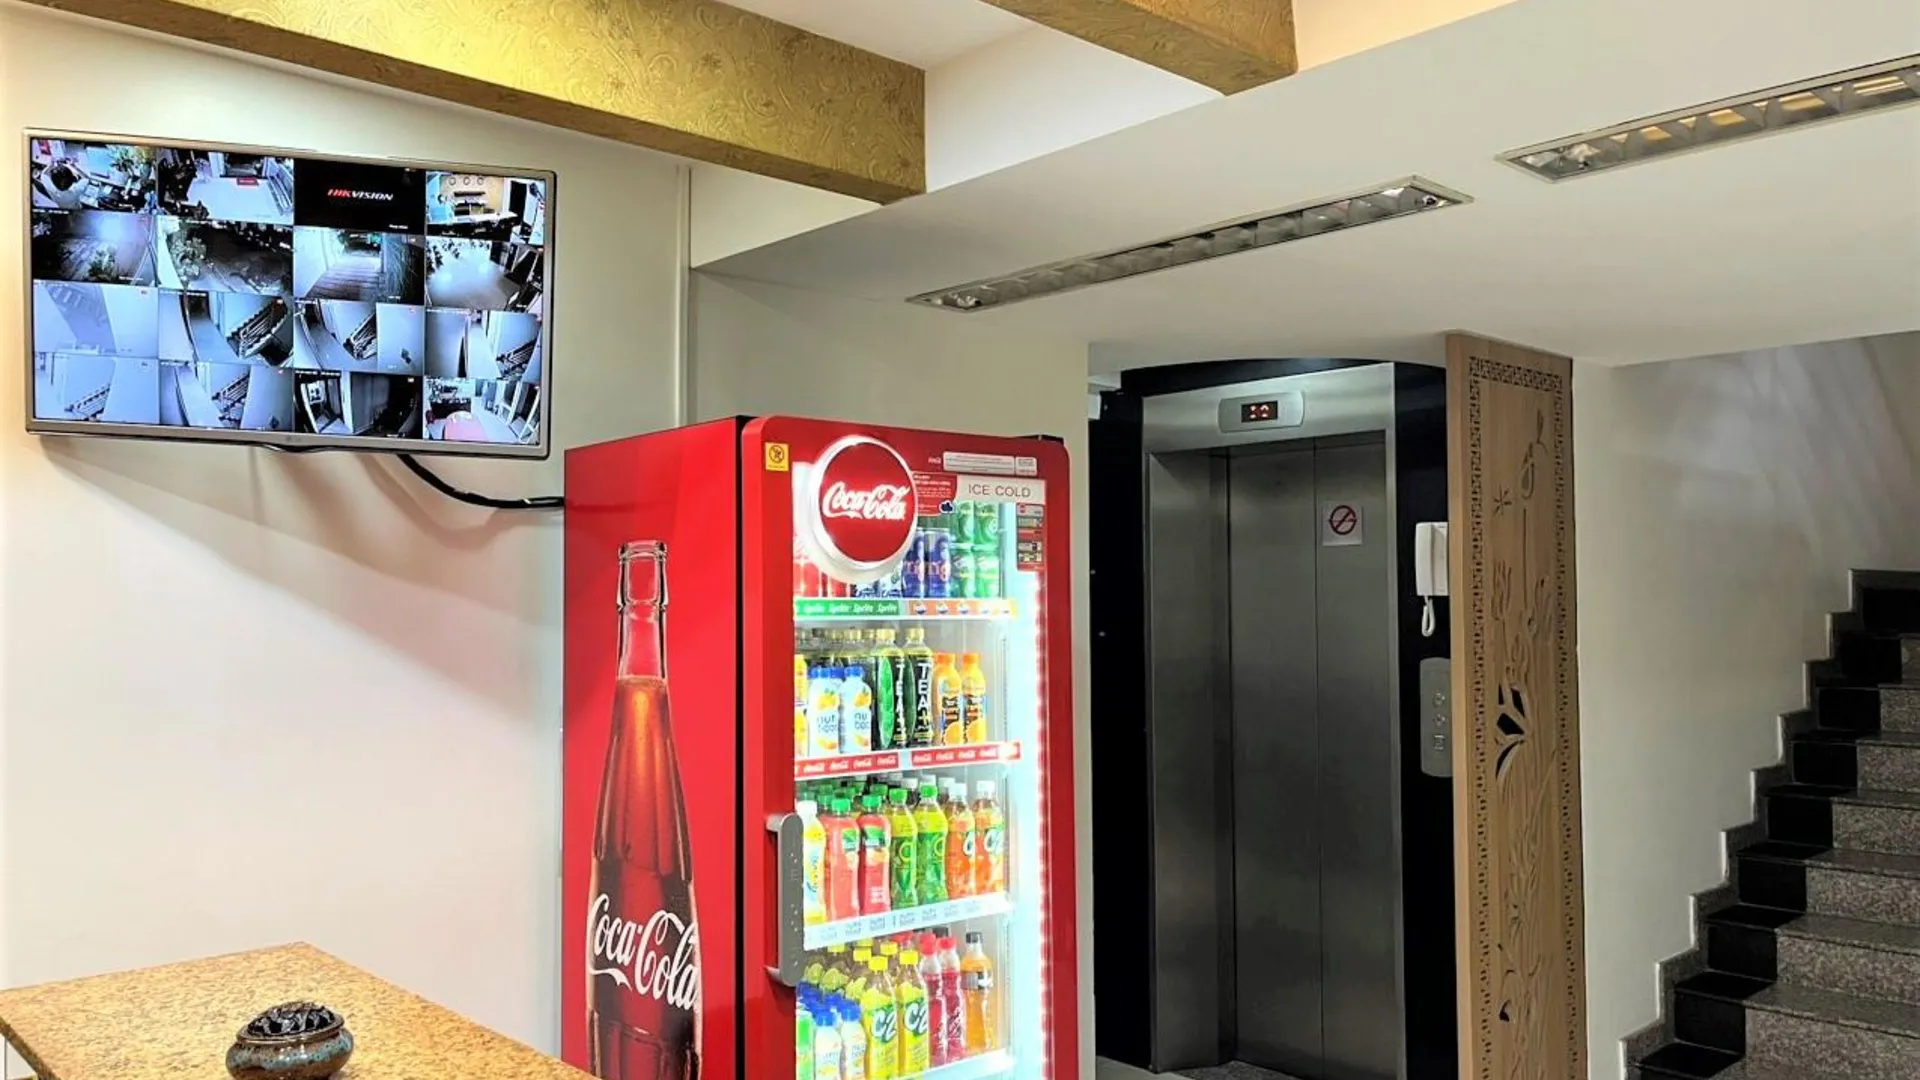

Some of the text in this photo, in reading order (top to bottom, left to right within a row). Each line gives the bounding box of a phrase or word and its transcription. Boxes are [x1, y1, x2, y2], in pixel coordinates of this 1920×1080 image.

[327, 188, 394, 201] HIKVISION
[968, 484, 1031, 498] ICE COLD
[821, 481, 912, 520] Coca-Cola
[877, 603, 898, 614] Sprite
[587, 893, 700, 1011] Coca-Cola
